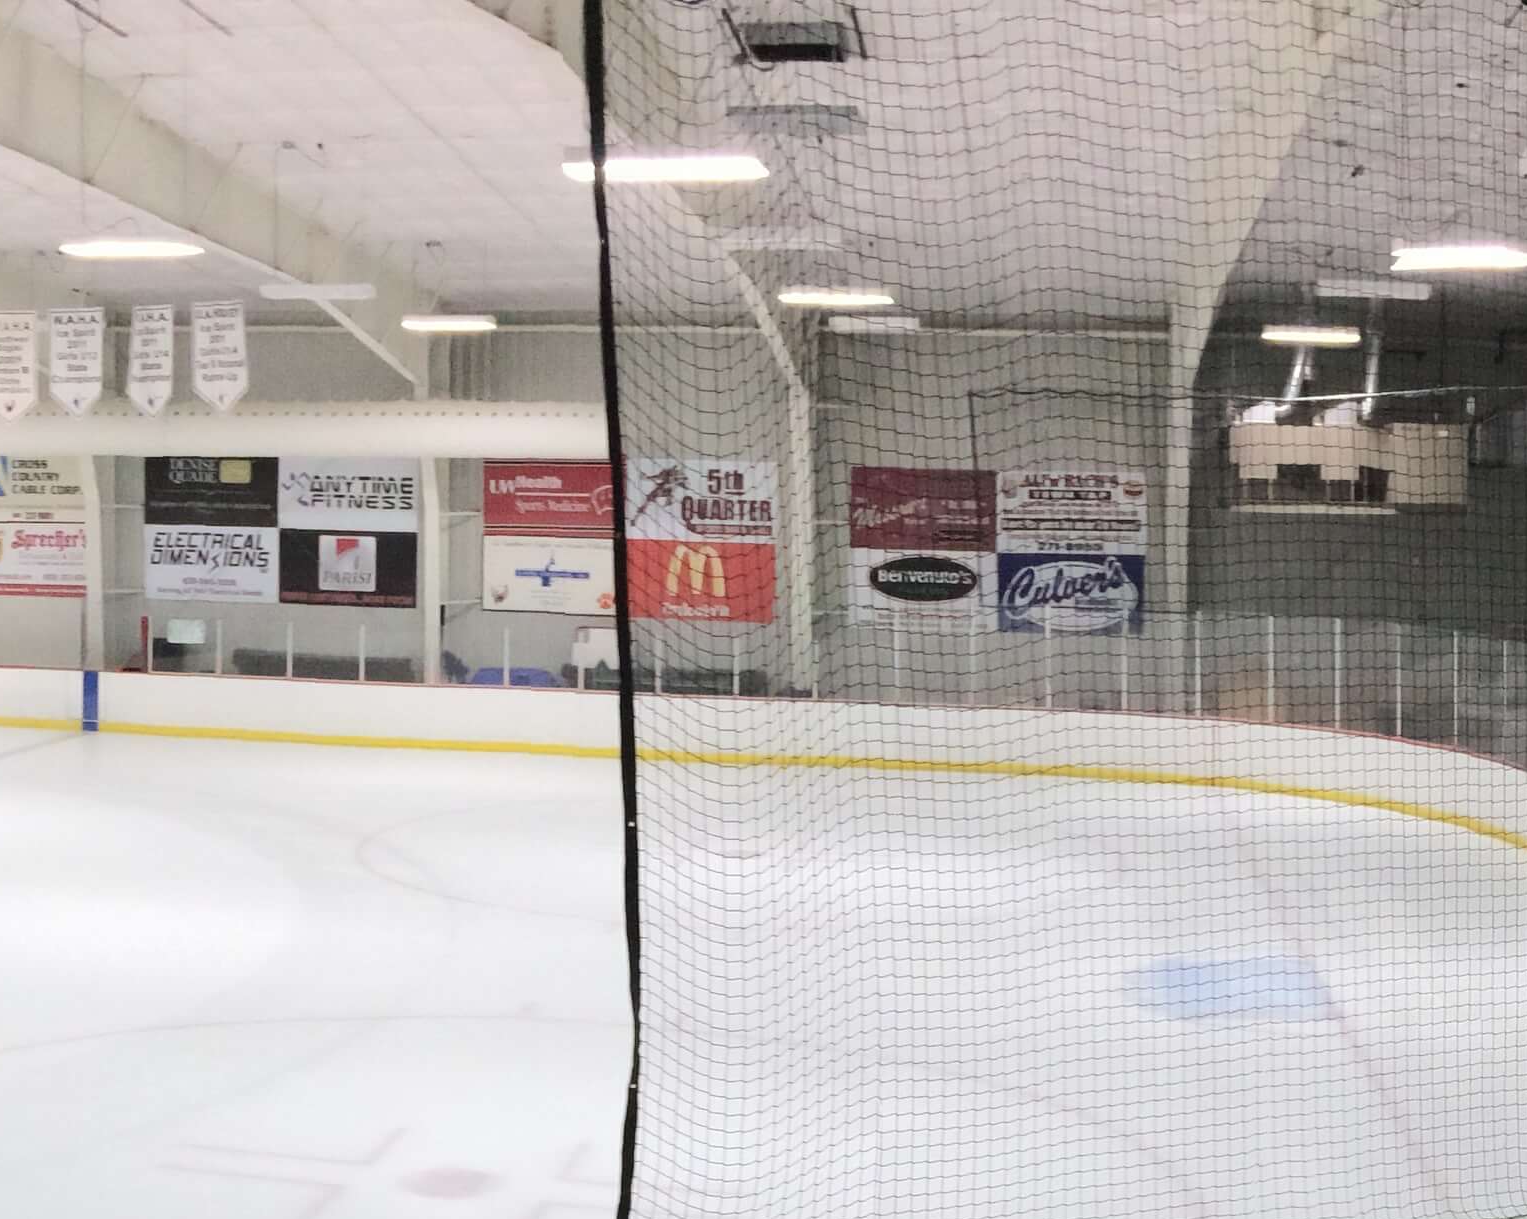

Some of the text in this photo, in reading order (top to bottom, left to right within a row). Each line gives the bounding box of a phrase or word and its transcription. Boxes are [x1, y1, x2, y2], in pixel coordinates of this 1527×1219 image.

[11, 459, 49, 470] CROSS
[11, 472, 60, 483] COUNTRY
[309, 474, 414, 494] ANYTIME
[515, 475, 563, 490] Health
[706, 468, 746, 495] 5th
[11, 484, 47, 496] CABLE
[310, 494, 414, 510] FITNESS
[680, 495, 773, 524] QUARTER
[152, 532, 265, 551] ELECTRICAL
[876, 568, 974, 586] Benvenuto's
[1007, 557, 1126, 615] Culver's
